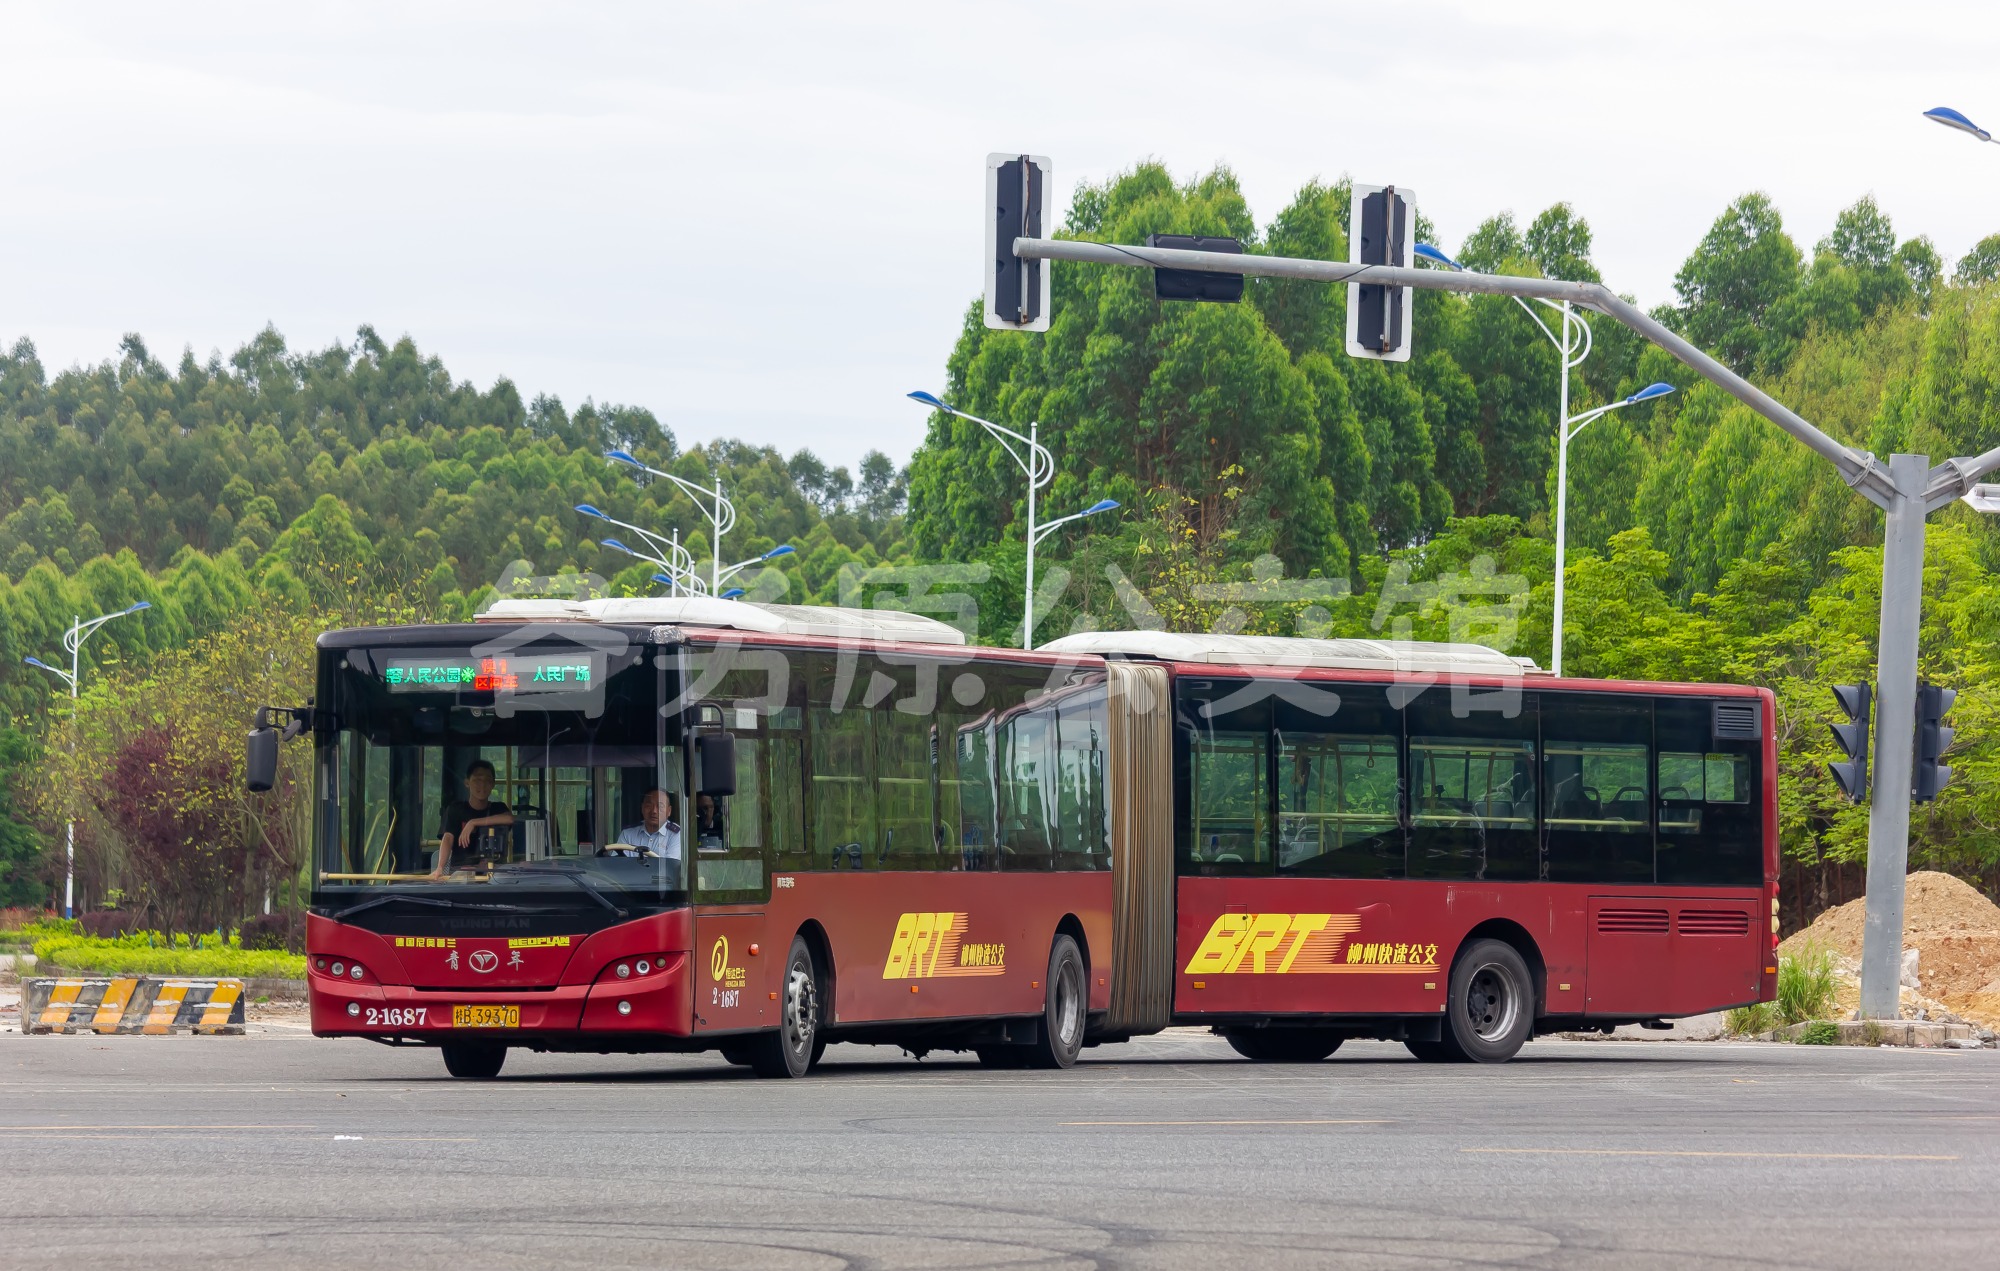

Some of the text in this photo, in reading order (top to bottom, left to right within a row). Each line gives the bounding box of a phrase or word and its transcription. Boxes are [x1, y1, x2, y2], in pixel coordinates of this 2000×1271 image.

[386, 667, 461, 683] 容人民公园
[475, 675, 519, 690] 区间车
[533, 665, 591, 682] 人民广场
[508, 936, 570, 948] NEOPLAN
[882, 912, 955, 979] BRT
[1184, 913, 1332, 974] BRT
[961, 943, 1006, 966] 柳州快速公交
[1346, 943, 1438, 964] 柳州快速公交
[365, 1008, 427, 1026] 2-1687
